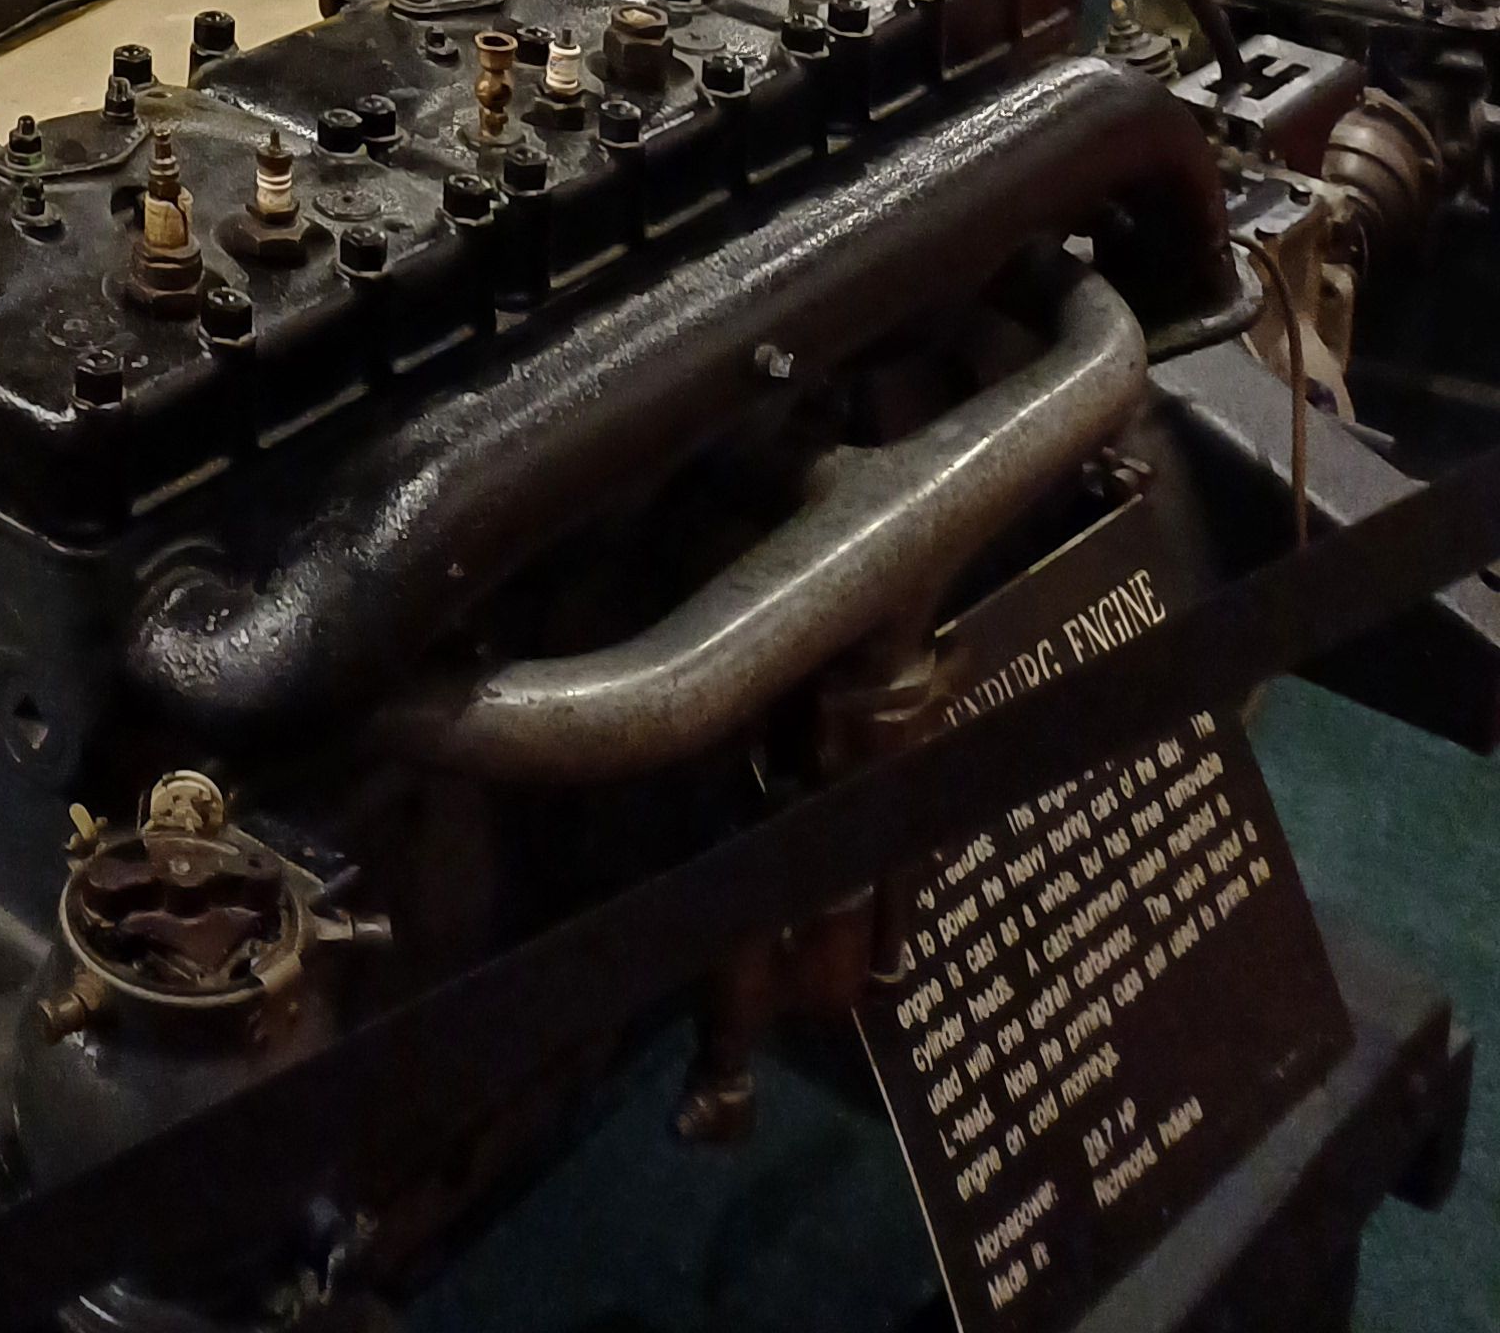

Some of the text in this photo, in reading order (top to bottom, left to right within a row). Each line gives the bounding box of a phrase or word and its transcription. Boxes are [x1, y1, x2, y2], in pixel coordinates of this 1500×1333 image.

[1062, 569, 1167, 664] ENGINE
[896, 977, 943, 1030] engine
[944, 961, 963, 990] is
[965, 931, 997, 974] cast
[999, 915, 1019, 947] as
[1021, 903, 1036, 928] a
[1079, 846, 1103, 880] but
[1102, 827, 1130, 859] has
[1130, 800, 1164, 838] three
[912, 1012, 965, 1072] cylinder
[1025, 948, 1040, 978] A
[1216, 793, 1231, 817] is
[916, 929, 935, 958] to
[937, 894, 978, 947] power
[981, 875, 1005, 908] the
[1004, 843, 1045, 888] heavy
[1046, 809, 1091, 855] touring
[1090, 786, 1118, 822] cars
[1118, 767, 1135, 800] of
[1134, 756, 1156, 786] the
[926, 1064, 963, 1116] used
[964, 1041, 995, 1083] with
[997, 1018, 1024, 1055] one
[1172, 863, 1206, 902] valve
[1205, 828, 1242, 874] layout
[1243, 819, 1257, 843] is
[1003, 1059, 1037, 1103] Note
[1038, 1037, 1063, 1071] the
[1064, 995, 1112, 1053] priming
[1112, 967, 1143, 1007] cups
[1168, 914, 1199, 959] used
[1198, 904, 1215, 931] to
[1215, 874, 1249, 920] prime
[1248, 856, 1270, 887] the
[956, 1145, 1001, 1202] engine
[1005, 1124, 1026, 1156] on
[1028, 1088, 1058, 1136] cold
[987, 1259, 1027, 1310] Made
